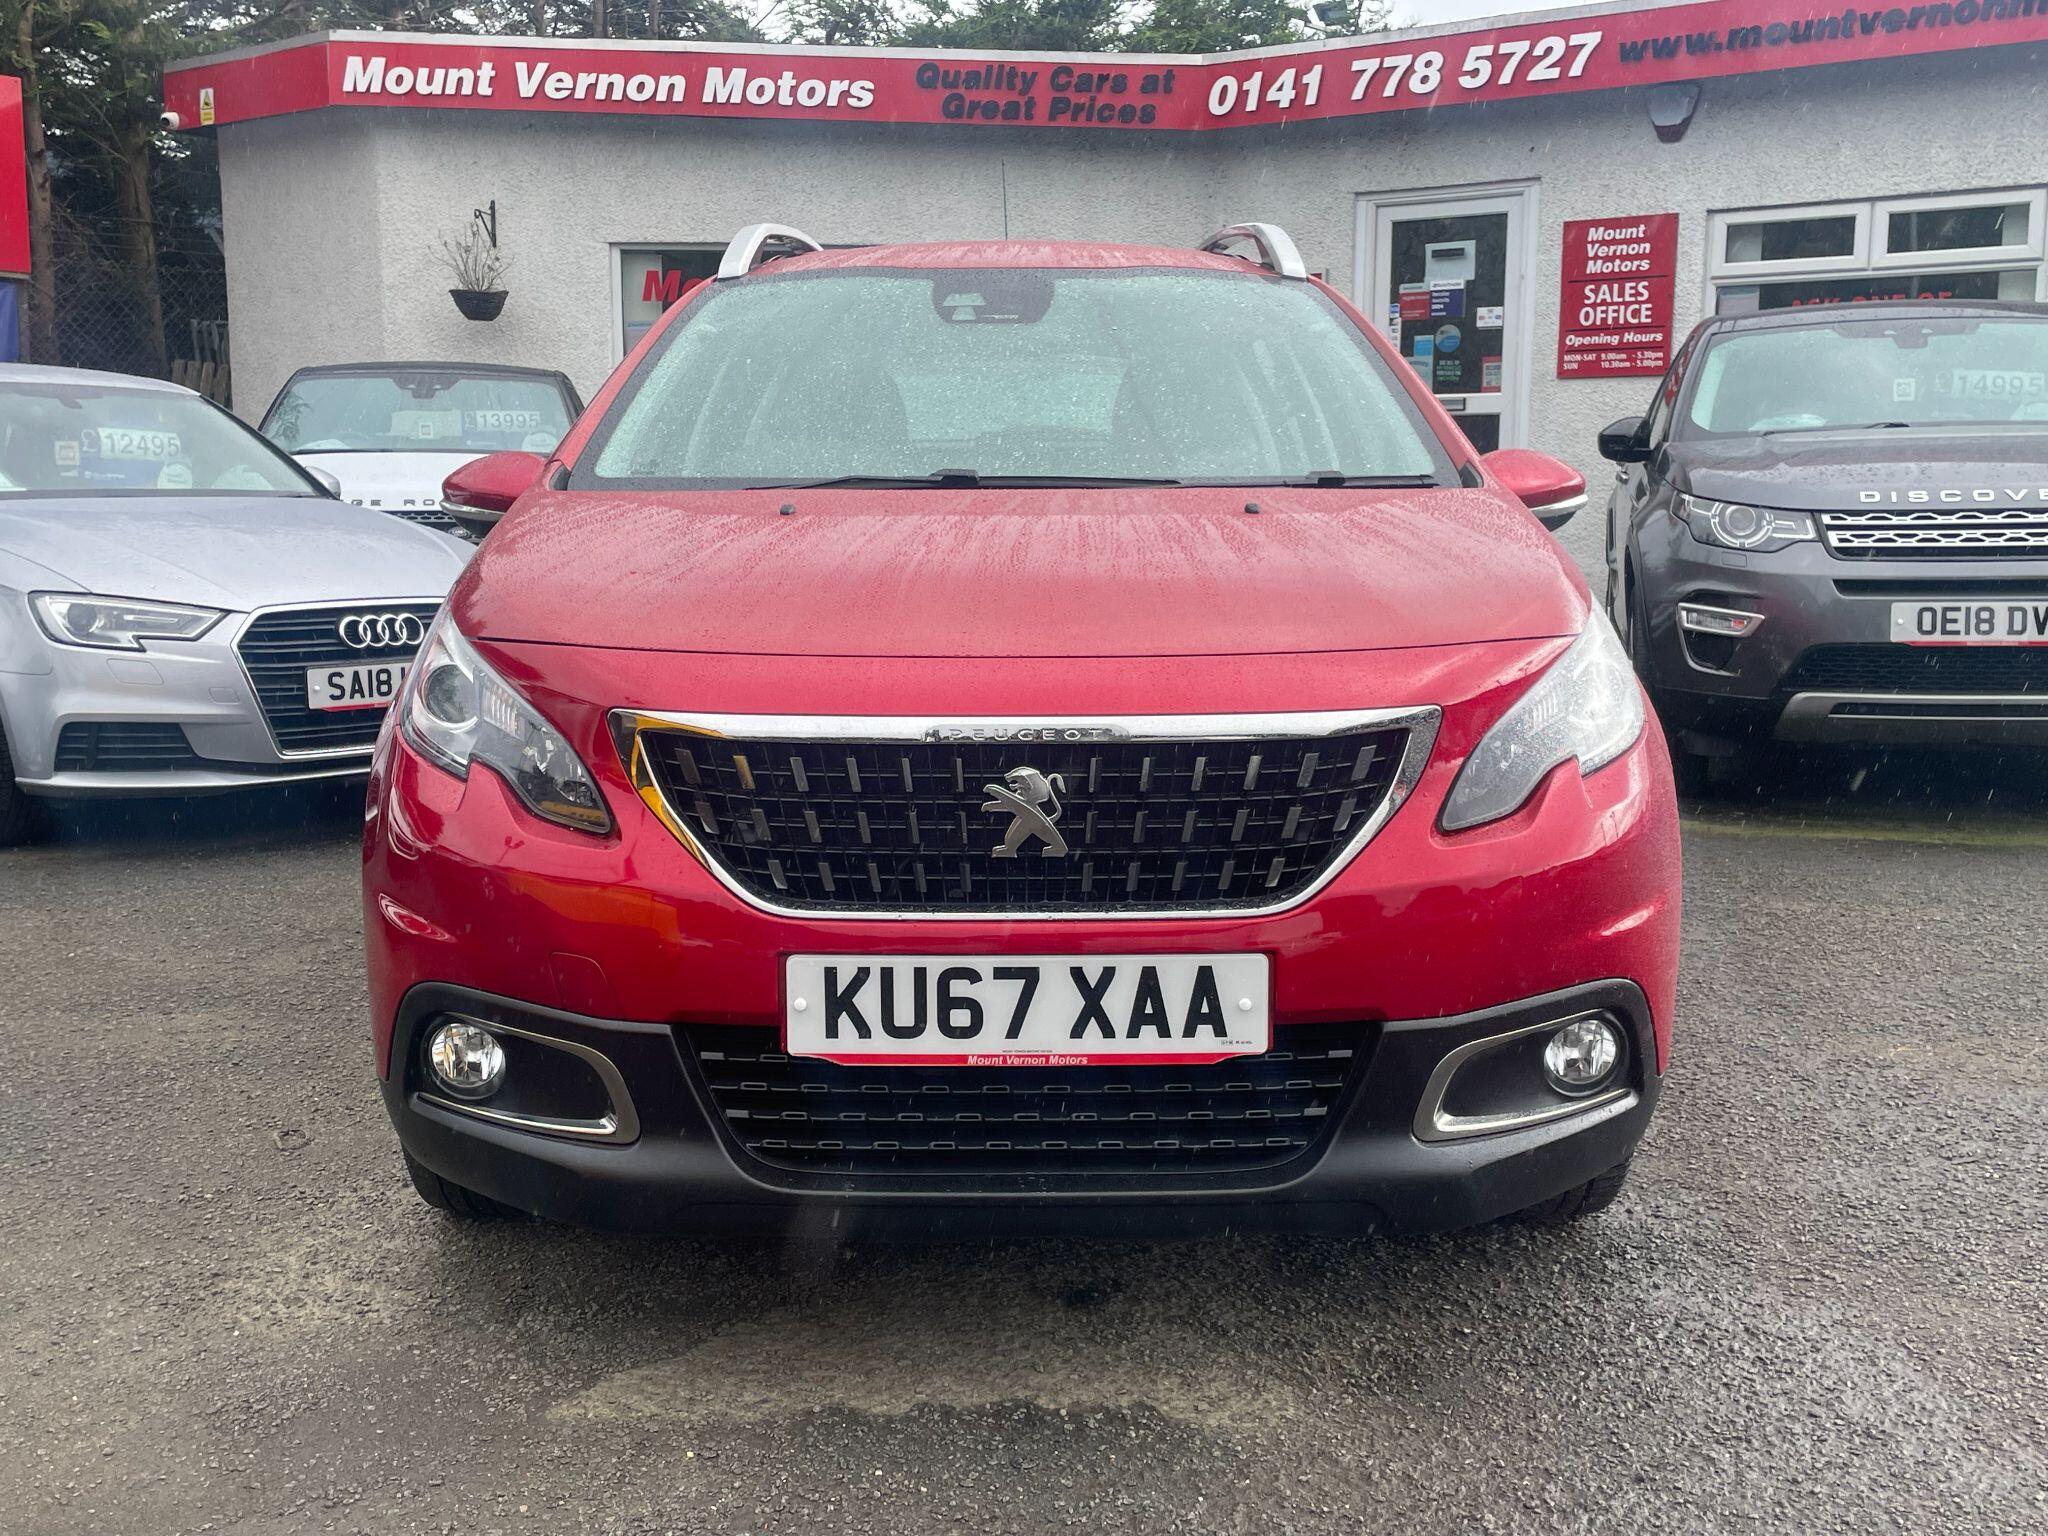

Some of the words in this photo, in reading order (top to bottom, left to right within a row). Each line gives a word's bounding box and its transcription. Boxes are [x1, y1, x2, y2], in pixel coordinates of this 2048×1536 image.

[342, 55, 496, 96] Mount
[514, 61, 687, 103] Vernon
[701, 66, 876, 108] Motors
[915, 62, 1038, 96] Quality
[1050, 65, 1128, 94] Cars
[1140, 69, 1176, 94] at
[1208, 63, 1323, 116] 0141
[1350, 51, 1442, 101] 778
[1458, 32, 1602, 88] 5727
[941, 92, 1036, 121] Great
[1047, 95, 1157, 124] Prices
[1587, 224, 1645, 242] Mount
[1586, 242, 1651, 258] Vernon
[1586, 259, 1651, 274] Motors
[1584, 281, 1650, 305] SALES
[1579, 303, 1653, 326] OFFICE
[1565, 333, 1620, 347] Opening
[1623, 332, 1664, 343] Hours
[1563, 353, 1597, 362] MON-SAT
[1600, 352, 1627, 360] 9.00am
[1563, 362, 1579, 370] SUN
[336, 499, 382, 507] GE
[1917, 606, 1995, 636] OE18
[327, 668, 392, 701] SA18
[949, 728, 1102, 741] PEUGEOT
[823, 966, 1040, 1040] KU67
[1069, 966, 1228, 1039] XAA
[967, 1055, 1003, 1065] Mount
[1006, 1055, 1045, 1065] Vernon
[1048, 1055, 1088, 1065] Motors
